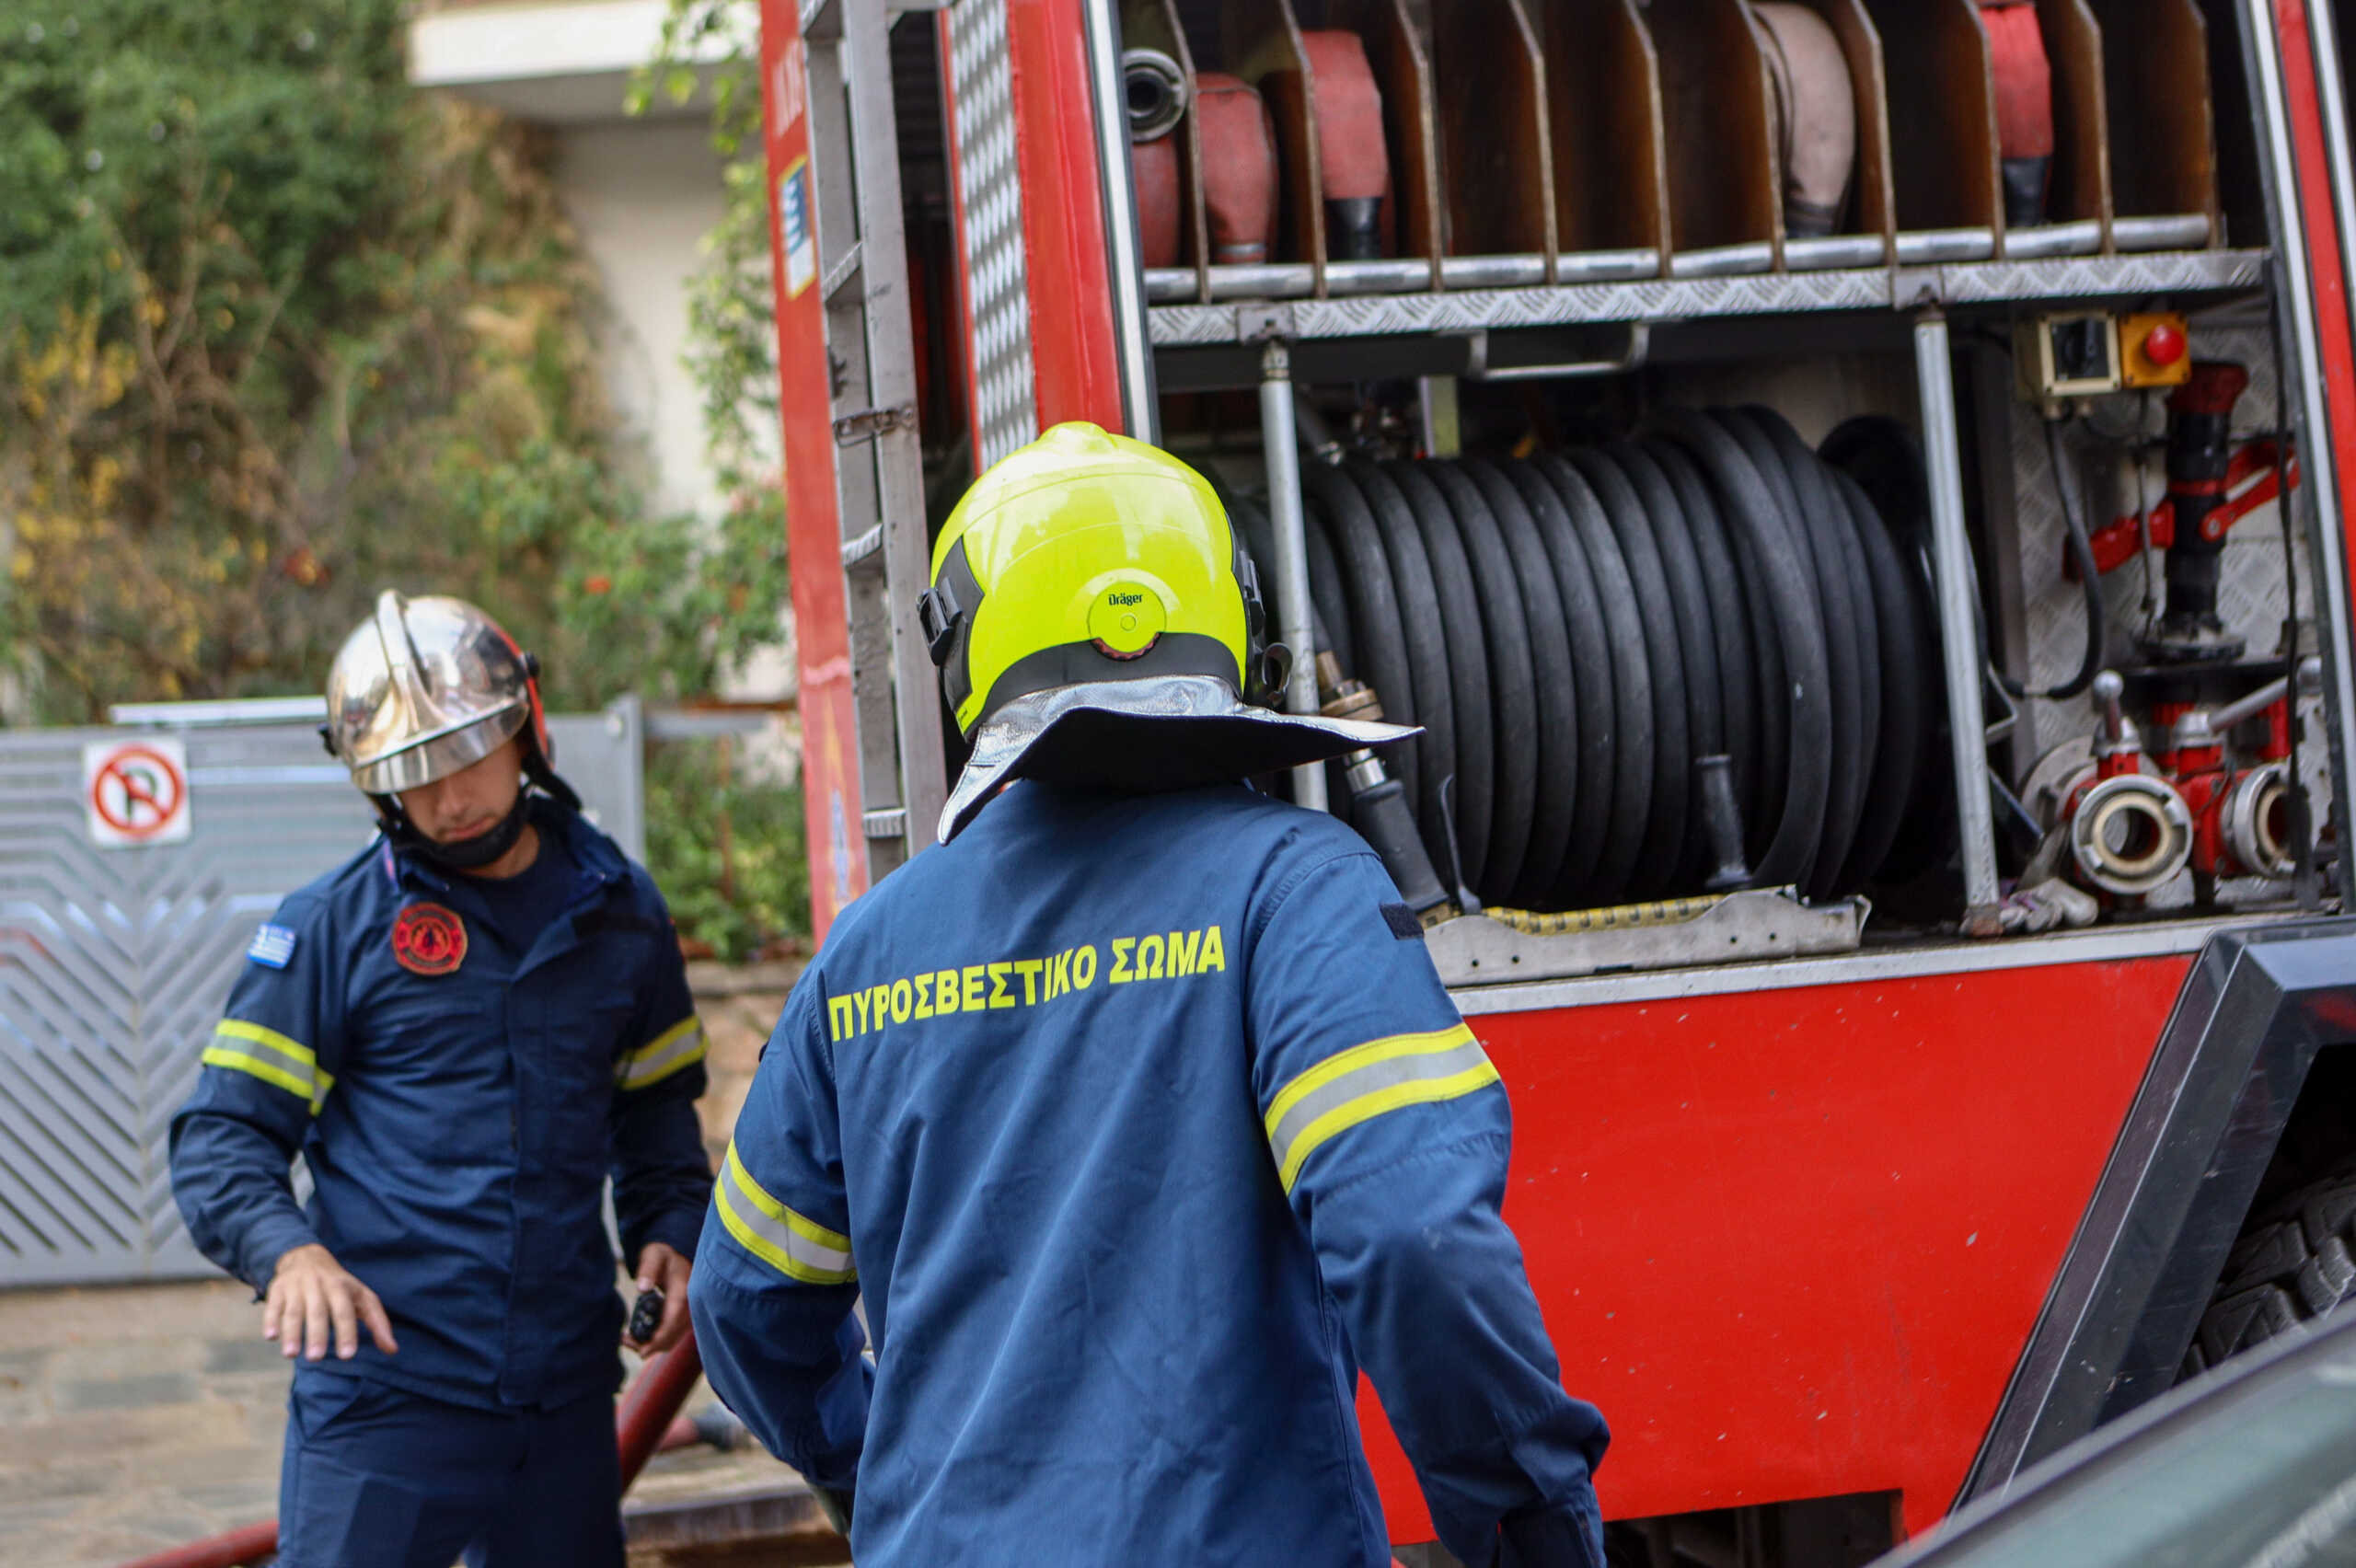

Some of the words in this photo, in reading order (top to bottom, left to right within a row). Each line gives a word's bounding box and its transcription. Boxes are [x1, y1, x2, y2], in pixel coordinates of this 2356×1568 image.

[1108, 592, 1143, 606] Dräger
[828, 945, 1098, 1042] ΠΥΡΟΣΒΕΣΤΙΚΟ
[1109, 926, 1226, 985] ΣΩΜΑ
